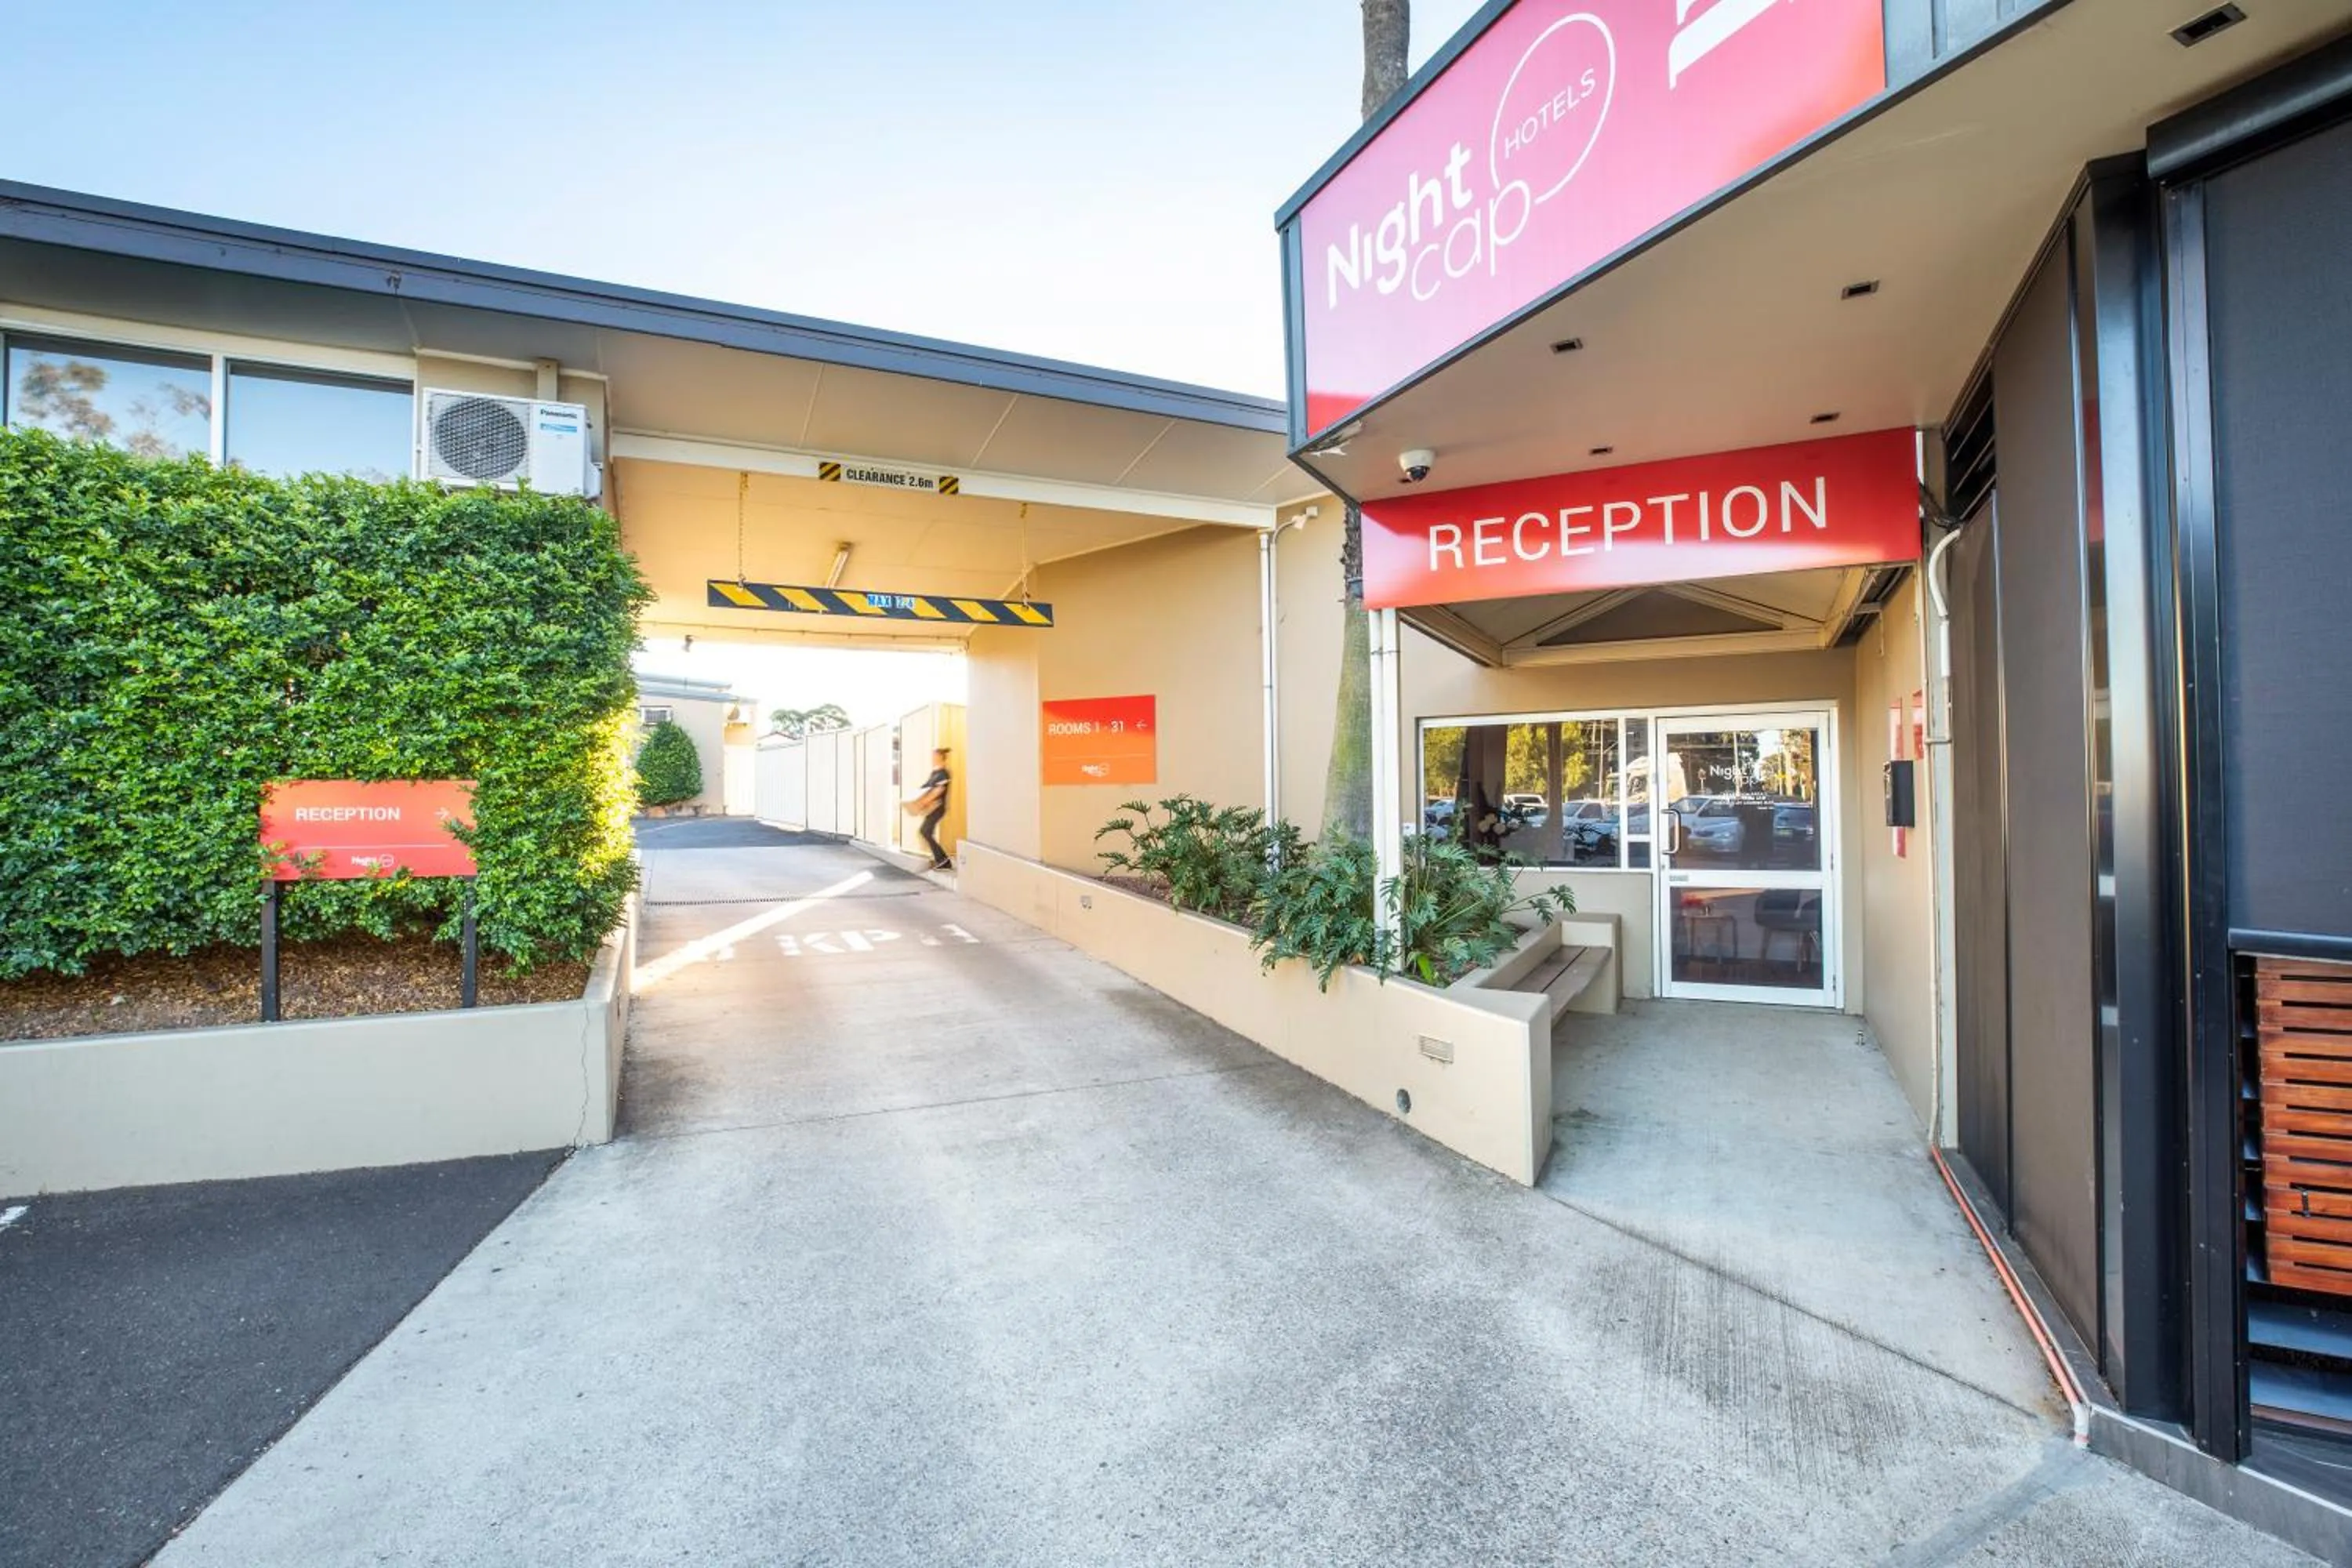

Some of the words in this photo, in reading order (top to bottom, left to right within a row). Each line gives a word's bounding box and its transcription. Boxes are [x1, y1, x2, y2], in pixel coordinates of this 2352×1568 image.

[1504, 67, 1596, 159] HOTELS
[1327, 141, 1472, 310] Night
[1411, 180, 1530, 301] cap
[846, 469, 905, 485] CLEARANCE
[909, 477, 934, 488] 2.6m
[1429, 476, 1828, 571] RECEPTION
[1048, 721, 1091, 735] ROOMS
[1110, 720, 1123, 734] 31
[296, 806, 401, 822] RECEPTION
